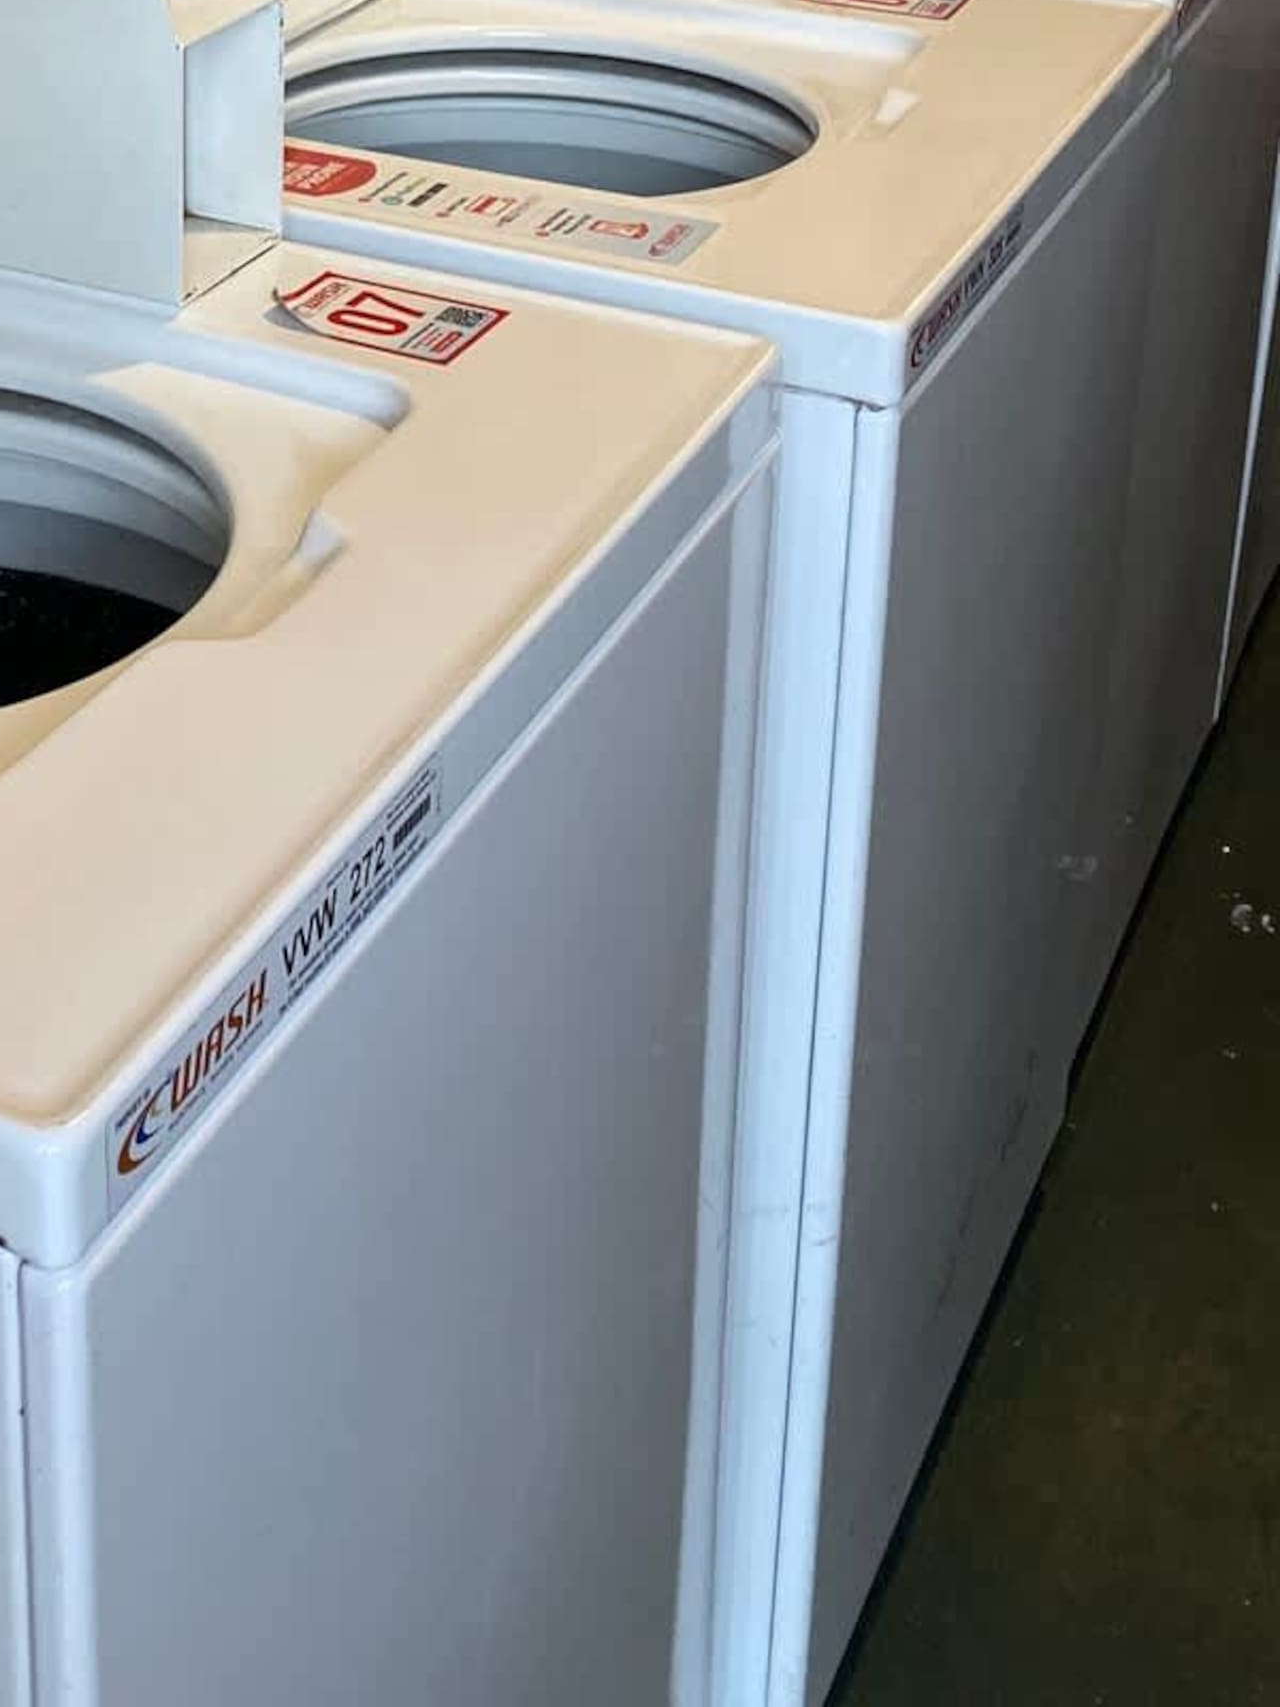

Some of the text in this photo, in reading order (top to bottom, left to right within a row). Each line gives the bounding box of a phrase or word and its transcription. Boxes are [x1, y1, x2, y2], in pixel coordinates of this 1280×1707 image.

[327, 291, 426, 336] 07
[349, 835, 386, 905] 272
[169, 968, 268, 1114] WASH
